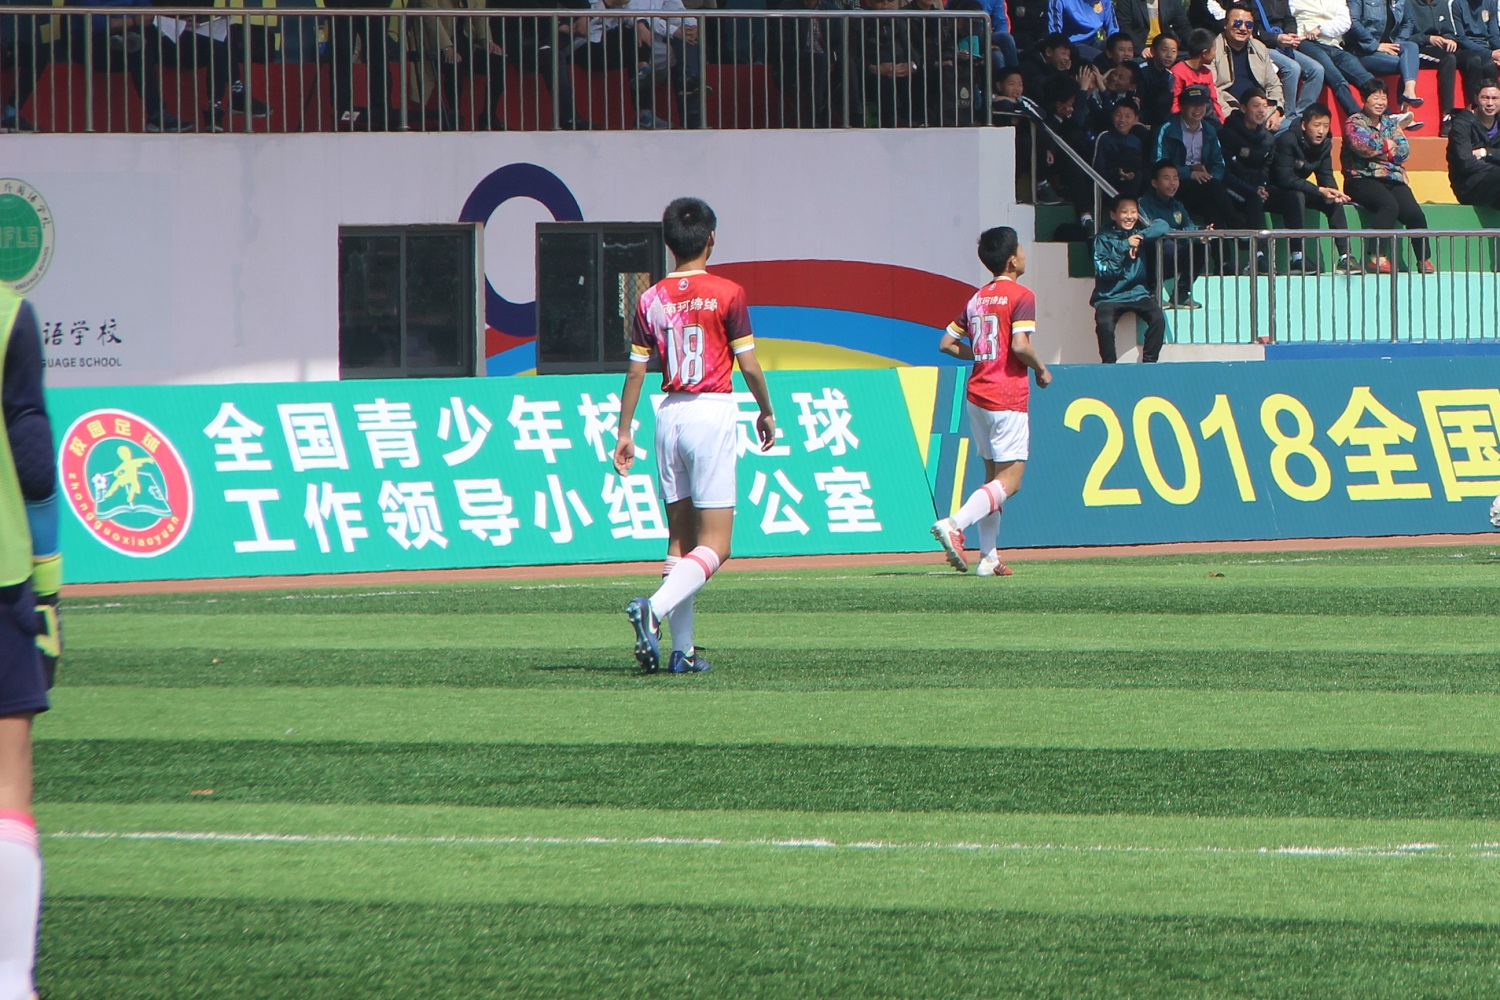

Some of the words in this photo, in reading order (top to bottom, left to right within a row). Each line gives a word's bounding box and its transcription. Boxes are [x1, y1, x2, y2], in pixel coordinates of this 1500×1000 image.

[0, 226, 38, 248] FLS
[79, 357, 122, 367] SCHOOL
[666, 323, 705, 386] 18
[971, 313, 999, 361] 23
[202, 387, 861, 472] 全国青少年校足球
[223, 466, 883, 554] 工作领导小组公室
